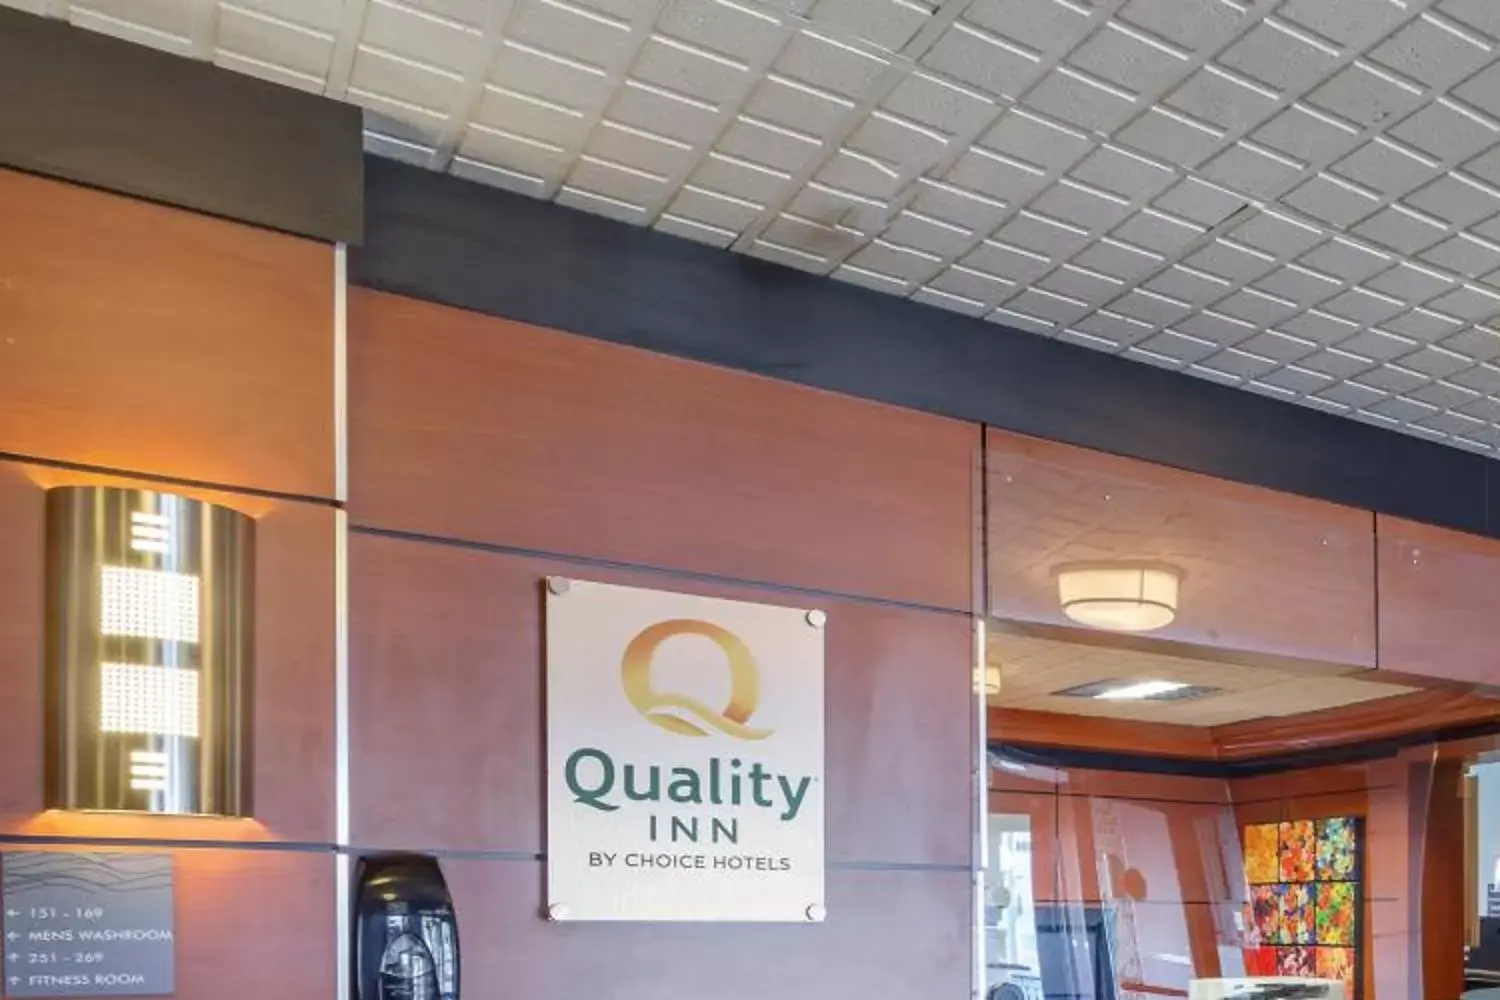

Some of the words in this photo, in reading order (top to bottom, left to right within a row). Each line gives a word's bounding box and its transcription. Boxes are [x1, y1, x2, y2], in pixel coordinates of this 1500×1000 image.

[564, 747, 811, 821] Quality
[649, 815, 738, 845] INN
[588, 852, 617, 868] BY
[624, 853, 706, 870] CHOICE
[712, 856, 791, 872] HOTELS
[30, 907, 56, 919] 151
[76, 907, 104, 919] 169
[28, 929, 74, 941] MENS
[79, 928, 173, 942] WASHROOM
[28, 952, 57, 964] 251
[74, 952, 104, 964] 269
[28, 974, 91, 987] FITNESS
[95, 973, 146, 986] ROOM
